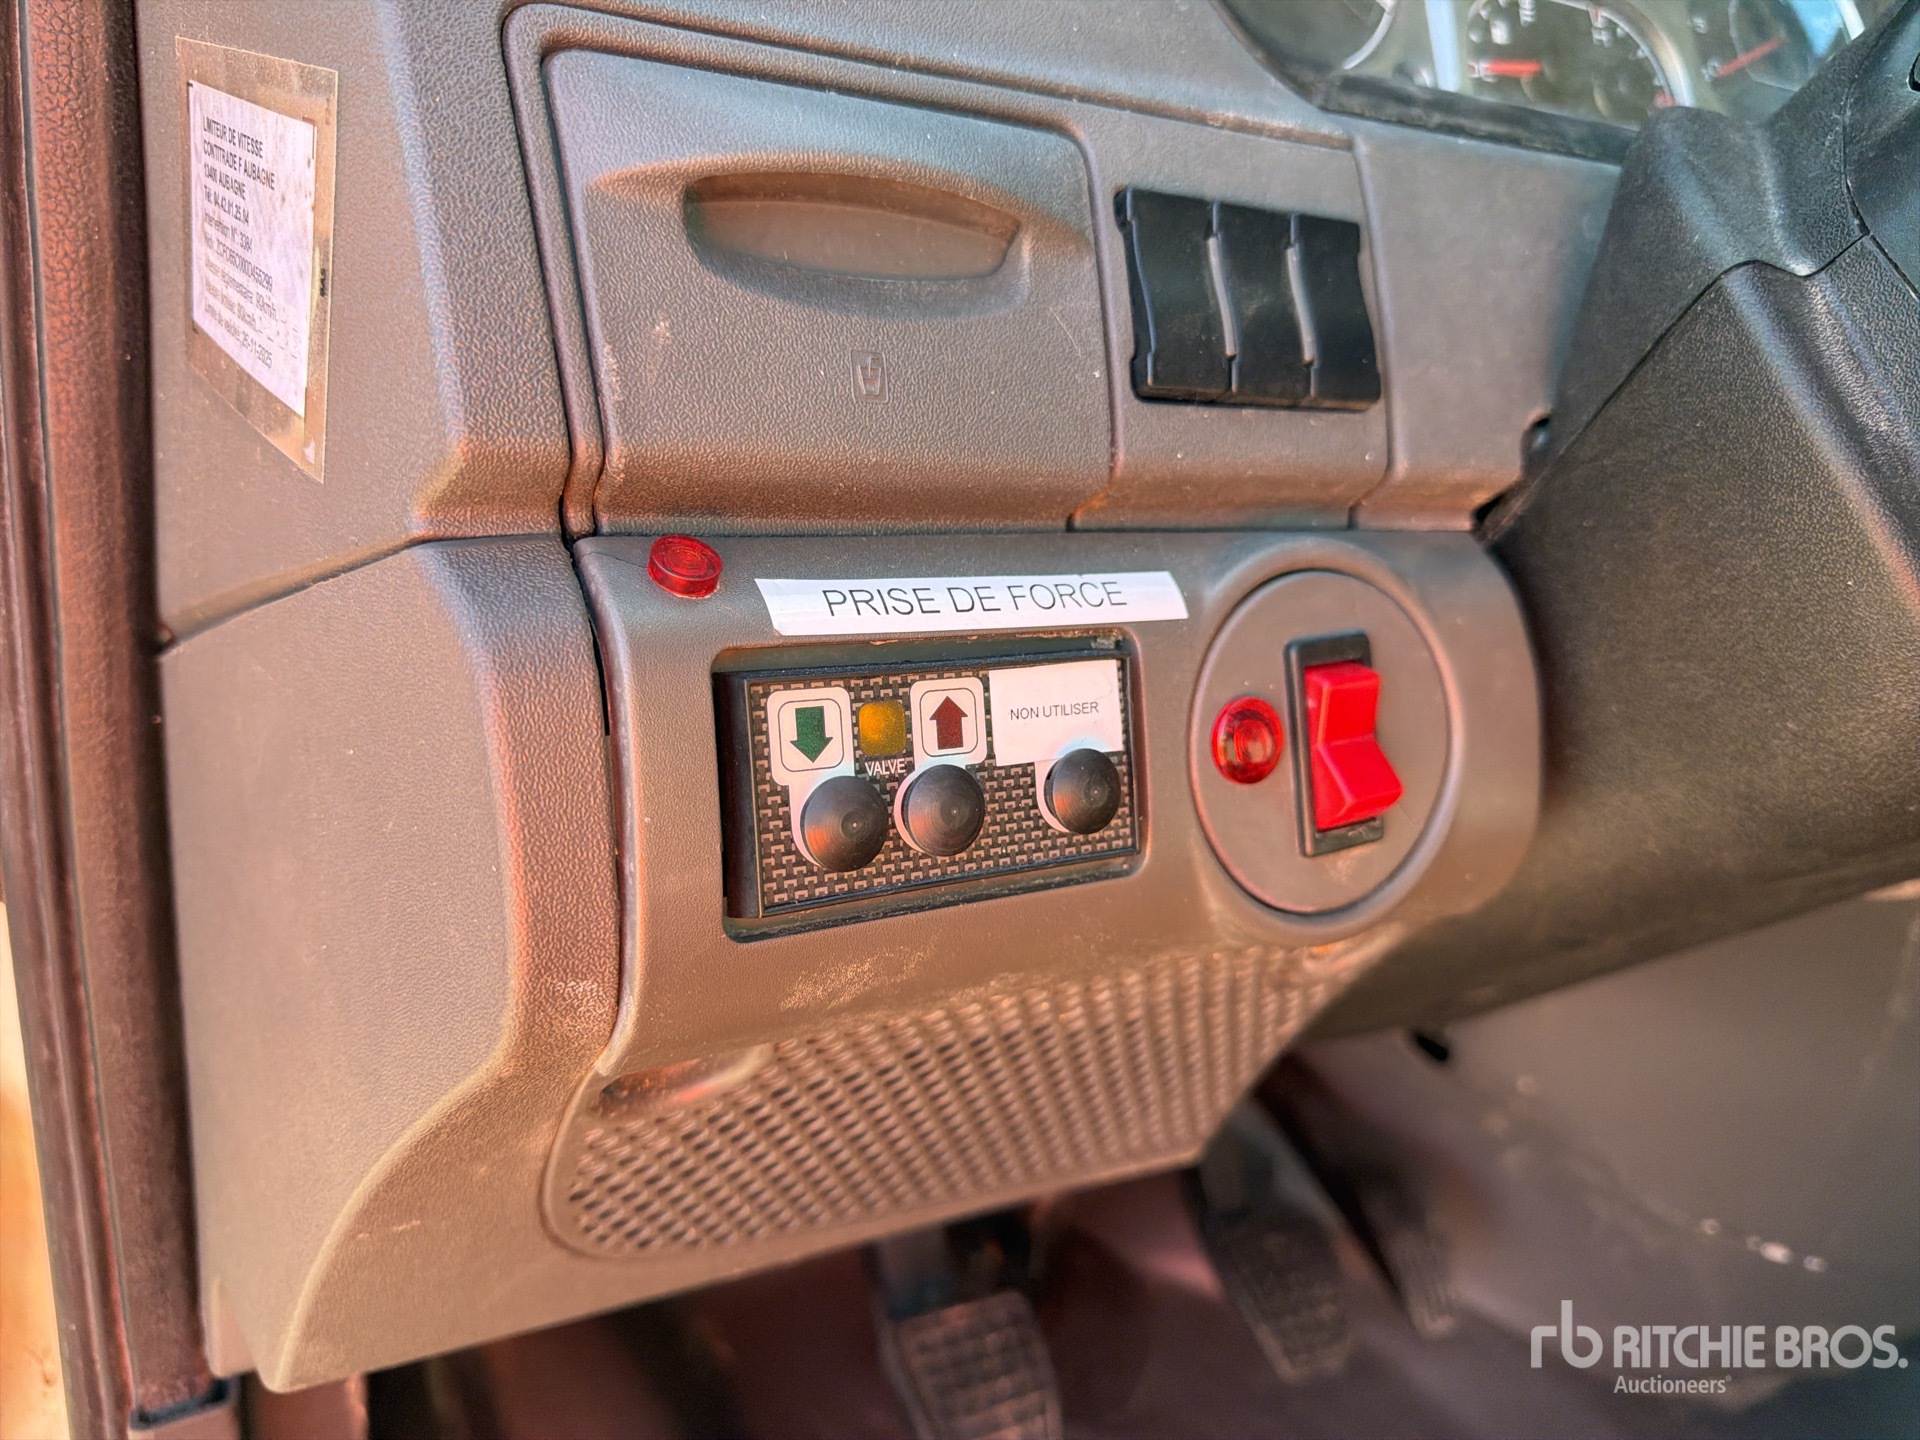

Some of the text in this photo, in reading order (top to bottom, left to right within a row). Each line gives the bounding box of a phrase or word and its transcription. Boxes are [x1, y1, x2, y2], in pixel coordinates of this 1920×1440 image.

[203, 115, 263, 159] LIMITEUR DE VITESSE
[218, 172, 246, 201] AUBAGNE
[243, 159, 275, 191] AUBAGNE
[822, 581, 1128, 616] PRISE DE FORCE
[1010, 702, 1099, 721] NON UTILISER
[864, 758, 906, 776] VALVE
